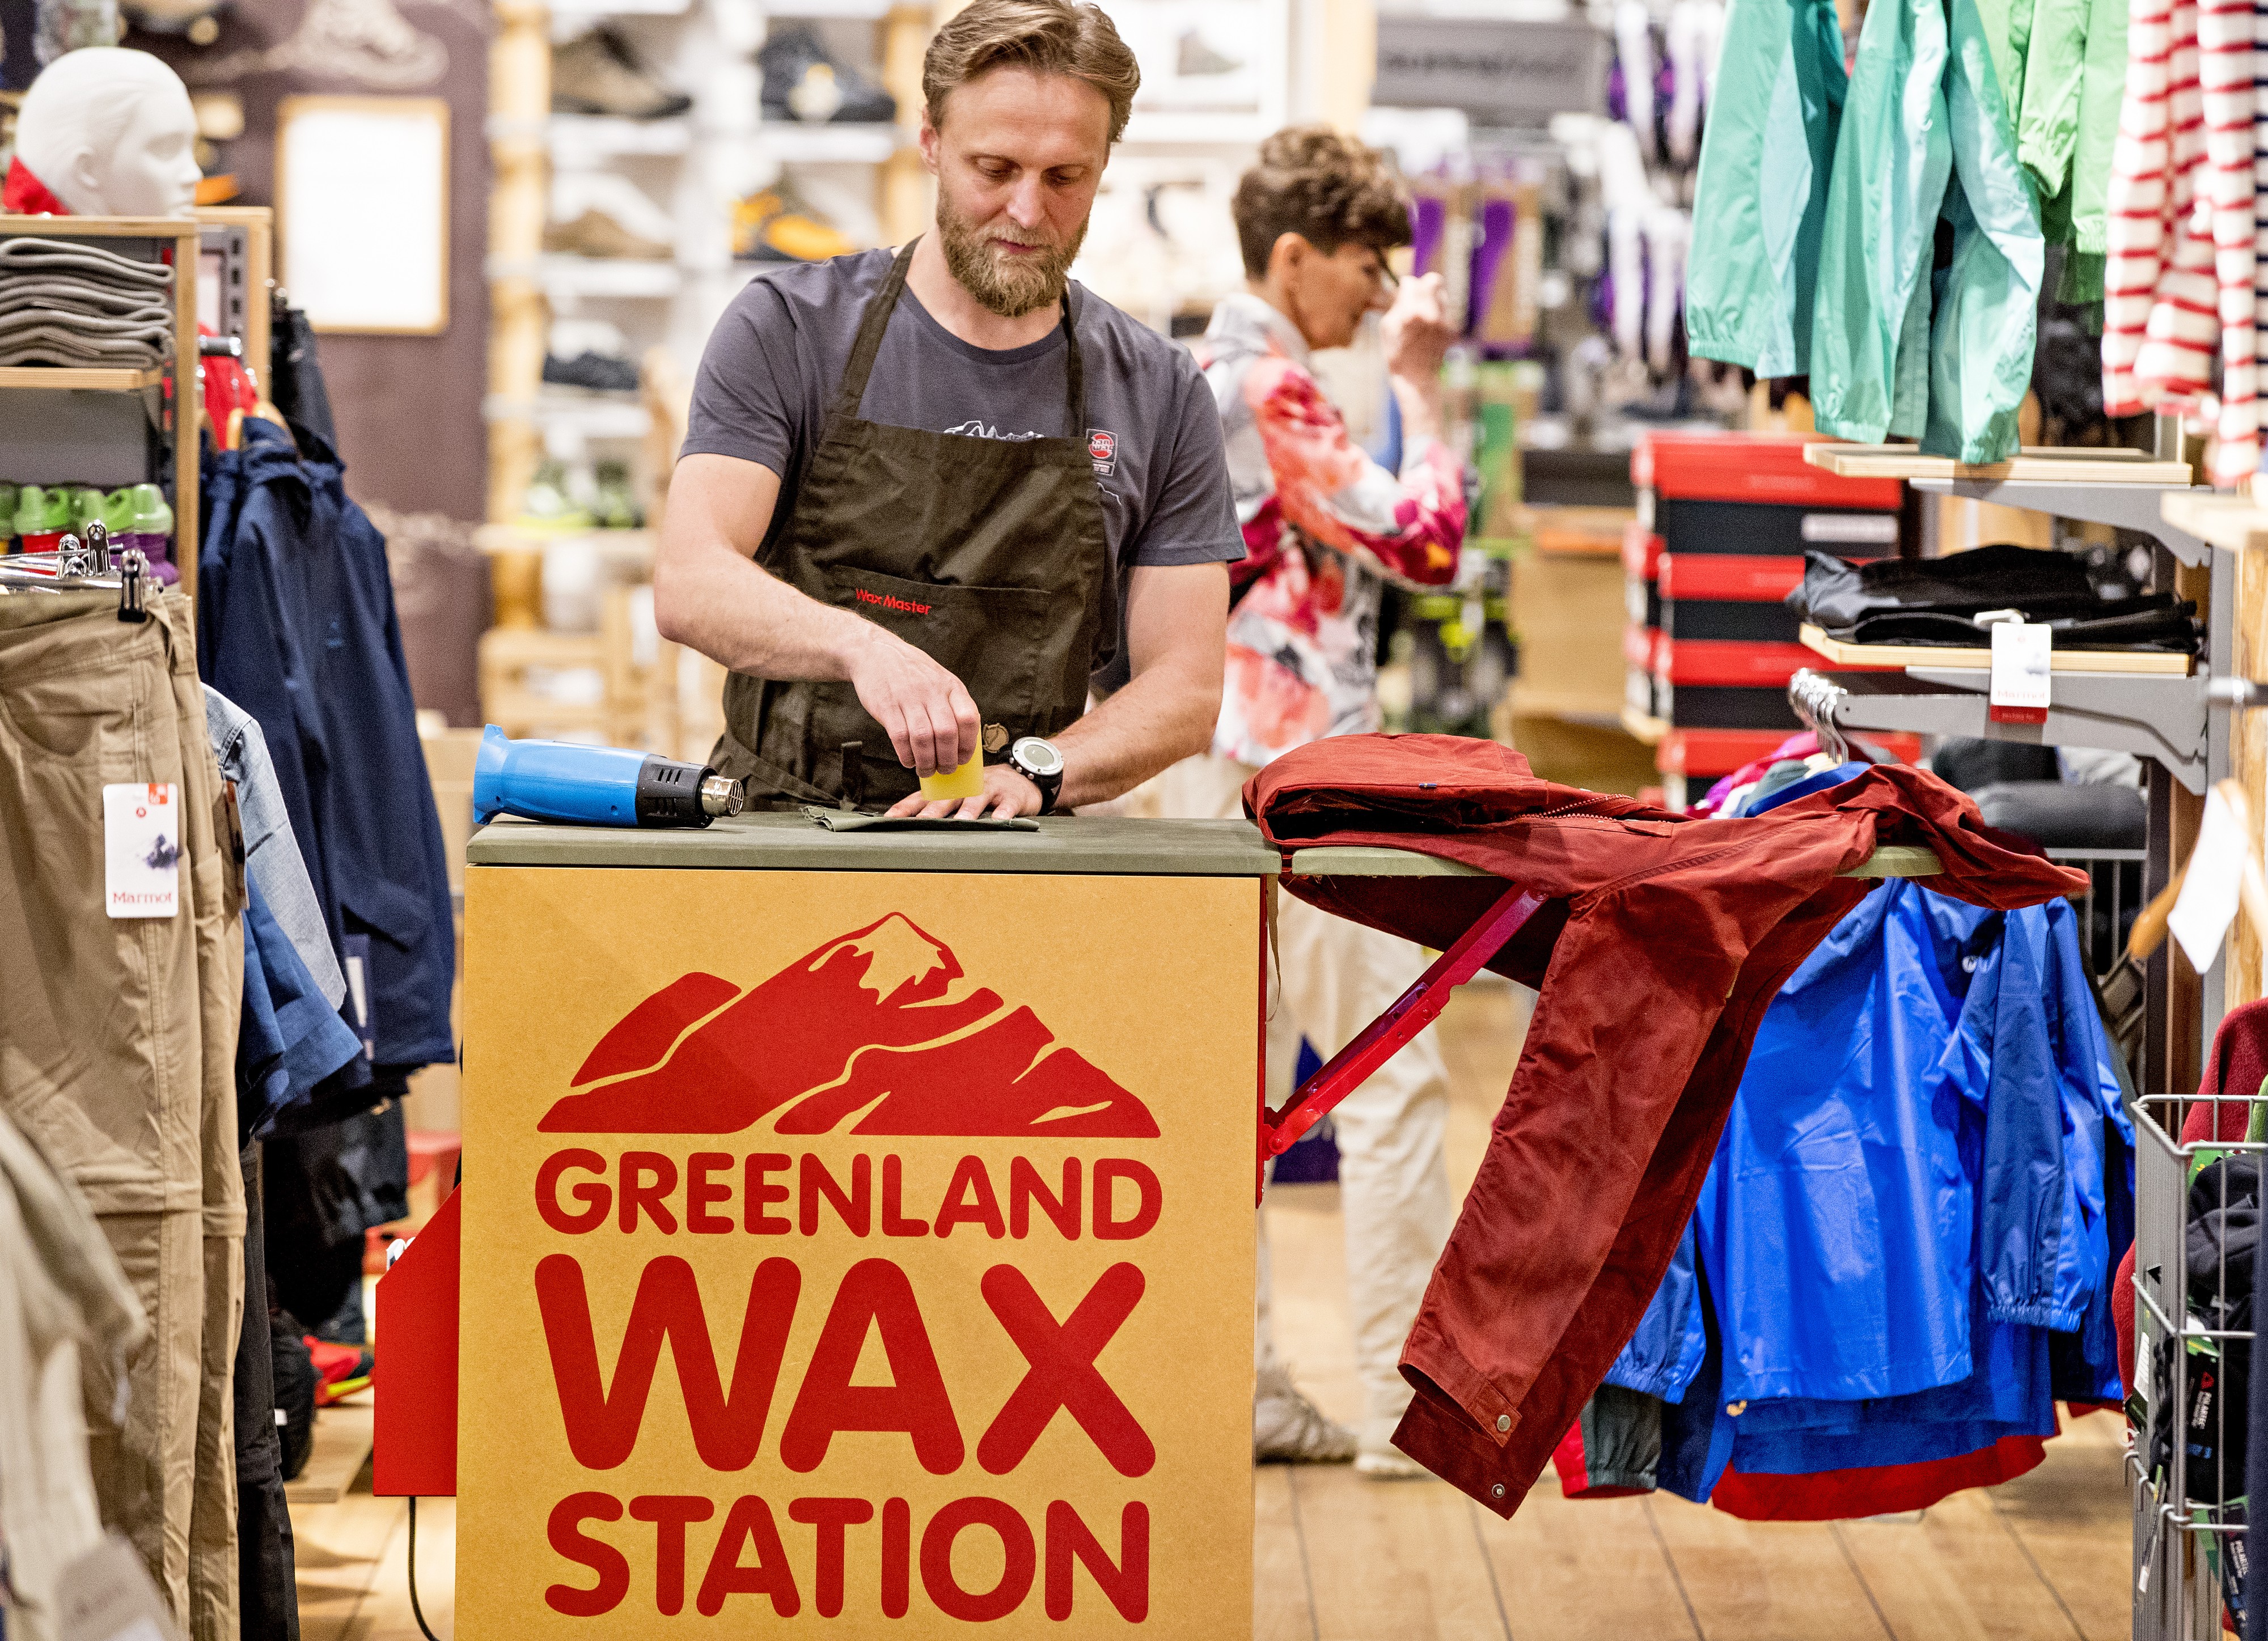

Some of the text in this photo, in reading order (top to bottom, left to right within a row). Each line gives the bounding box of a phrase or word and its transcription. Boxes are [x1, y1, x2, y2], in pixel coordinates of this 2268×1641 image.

[856, 588, 932, 615] Wax Master
[113, 892, 172, 904] Marmot
[535, 1148, 1162, 1240] GREENLAND
[534, 1253, 1156, 1478] WAX
[544, 1491, 1150, 1623] STATION
